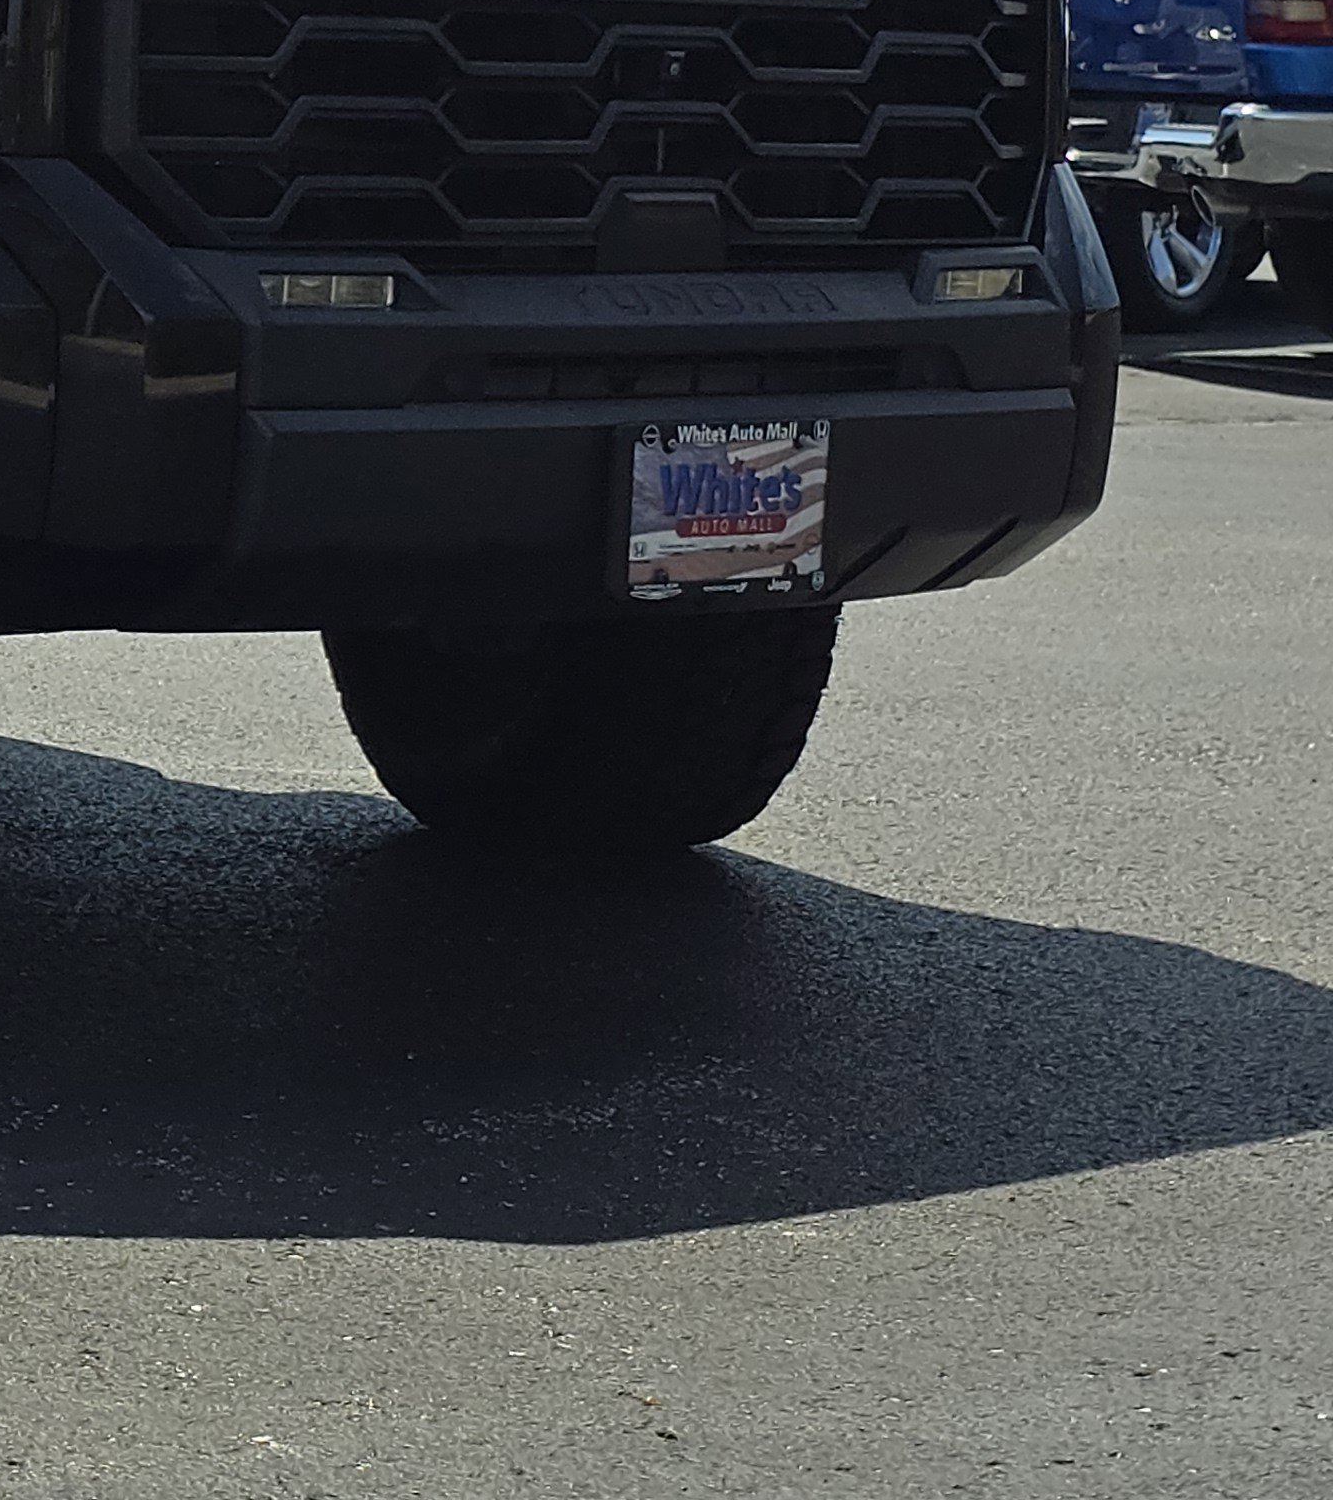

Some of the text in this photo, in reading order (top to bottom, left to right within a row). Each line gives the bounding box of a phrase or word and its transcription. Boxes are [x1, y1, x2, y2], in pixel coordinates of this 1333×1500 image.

[677, 421, 798, 443] White's Auto Mall
[659, 463, 802, 516] White's
[690, 517, 773, 534] AUTO MALL
